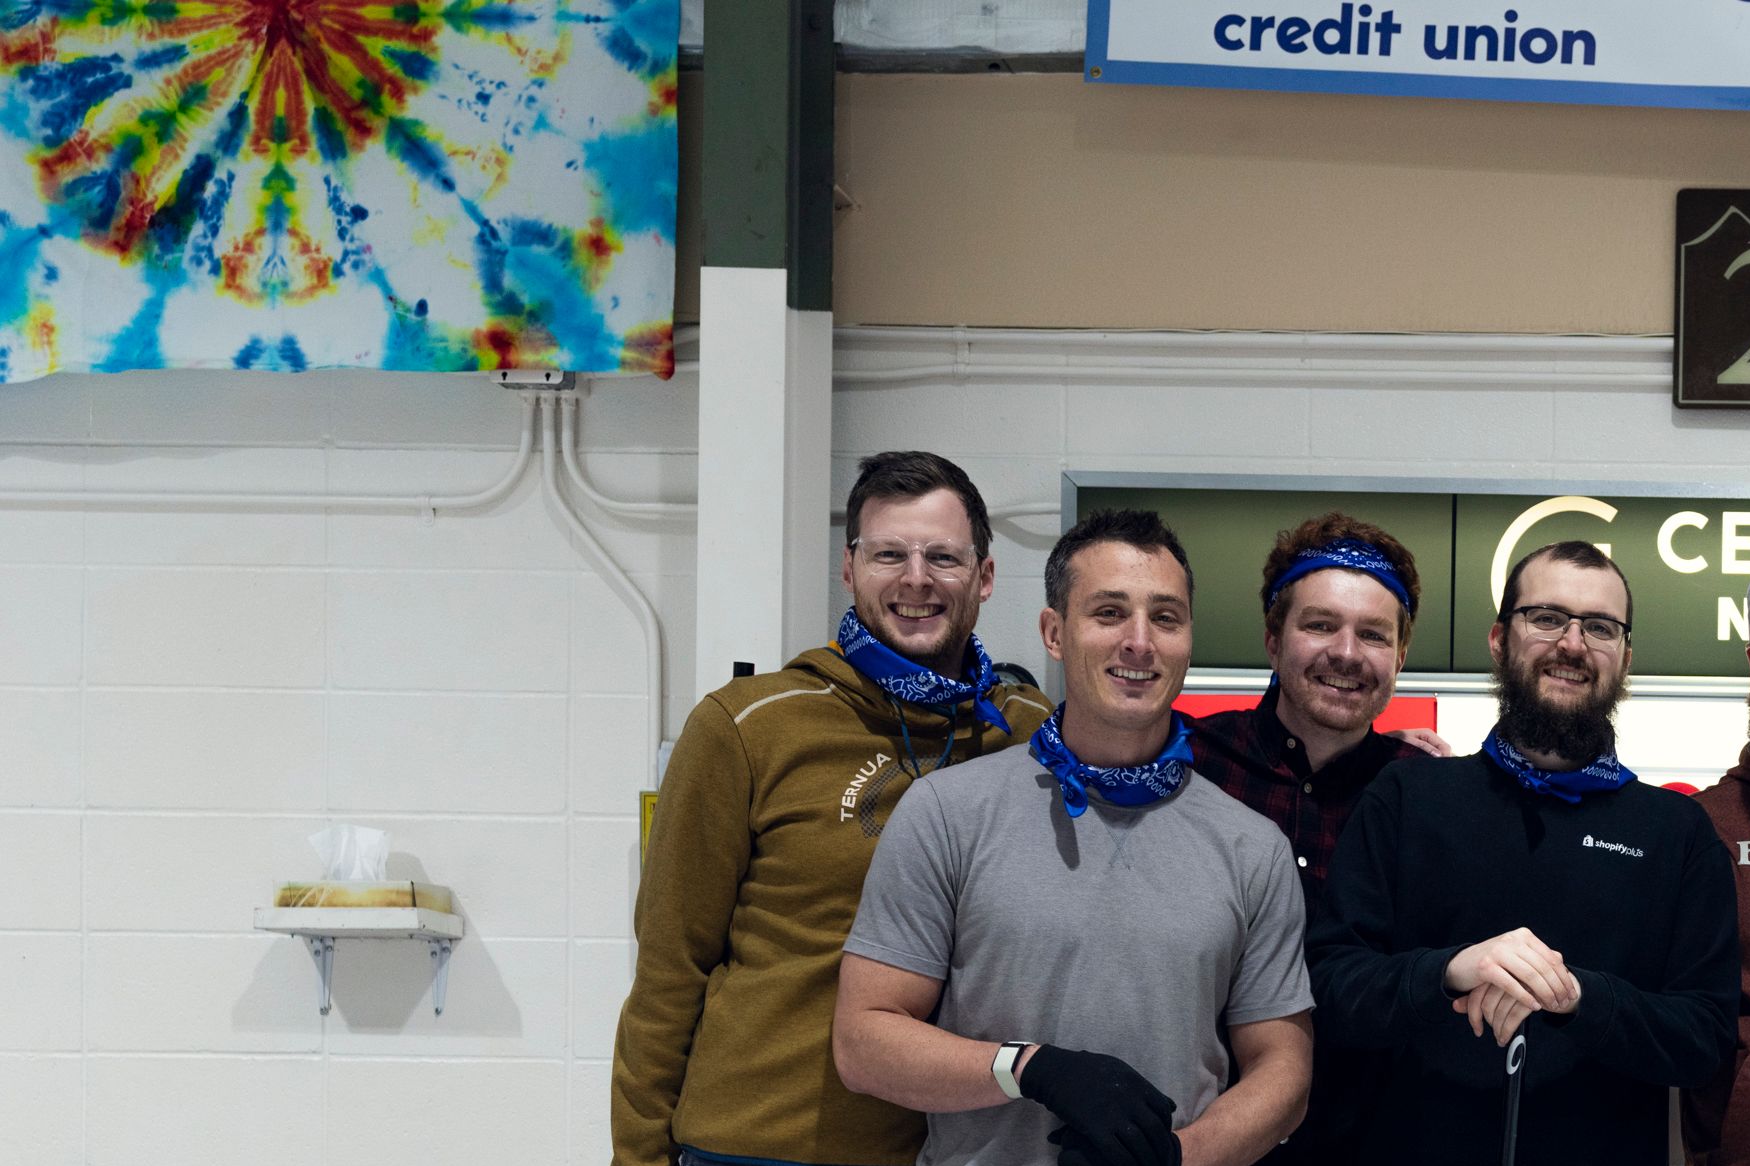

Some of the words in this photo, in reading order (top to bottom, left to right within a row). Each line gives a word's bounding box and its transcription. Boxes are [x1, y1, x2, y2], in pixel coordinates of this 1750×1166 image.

[1212, 2, 1401, 57] credit
[1423, 10, 1597, 65] union
[840, 752, 891, 822] TERNUA
